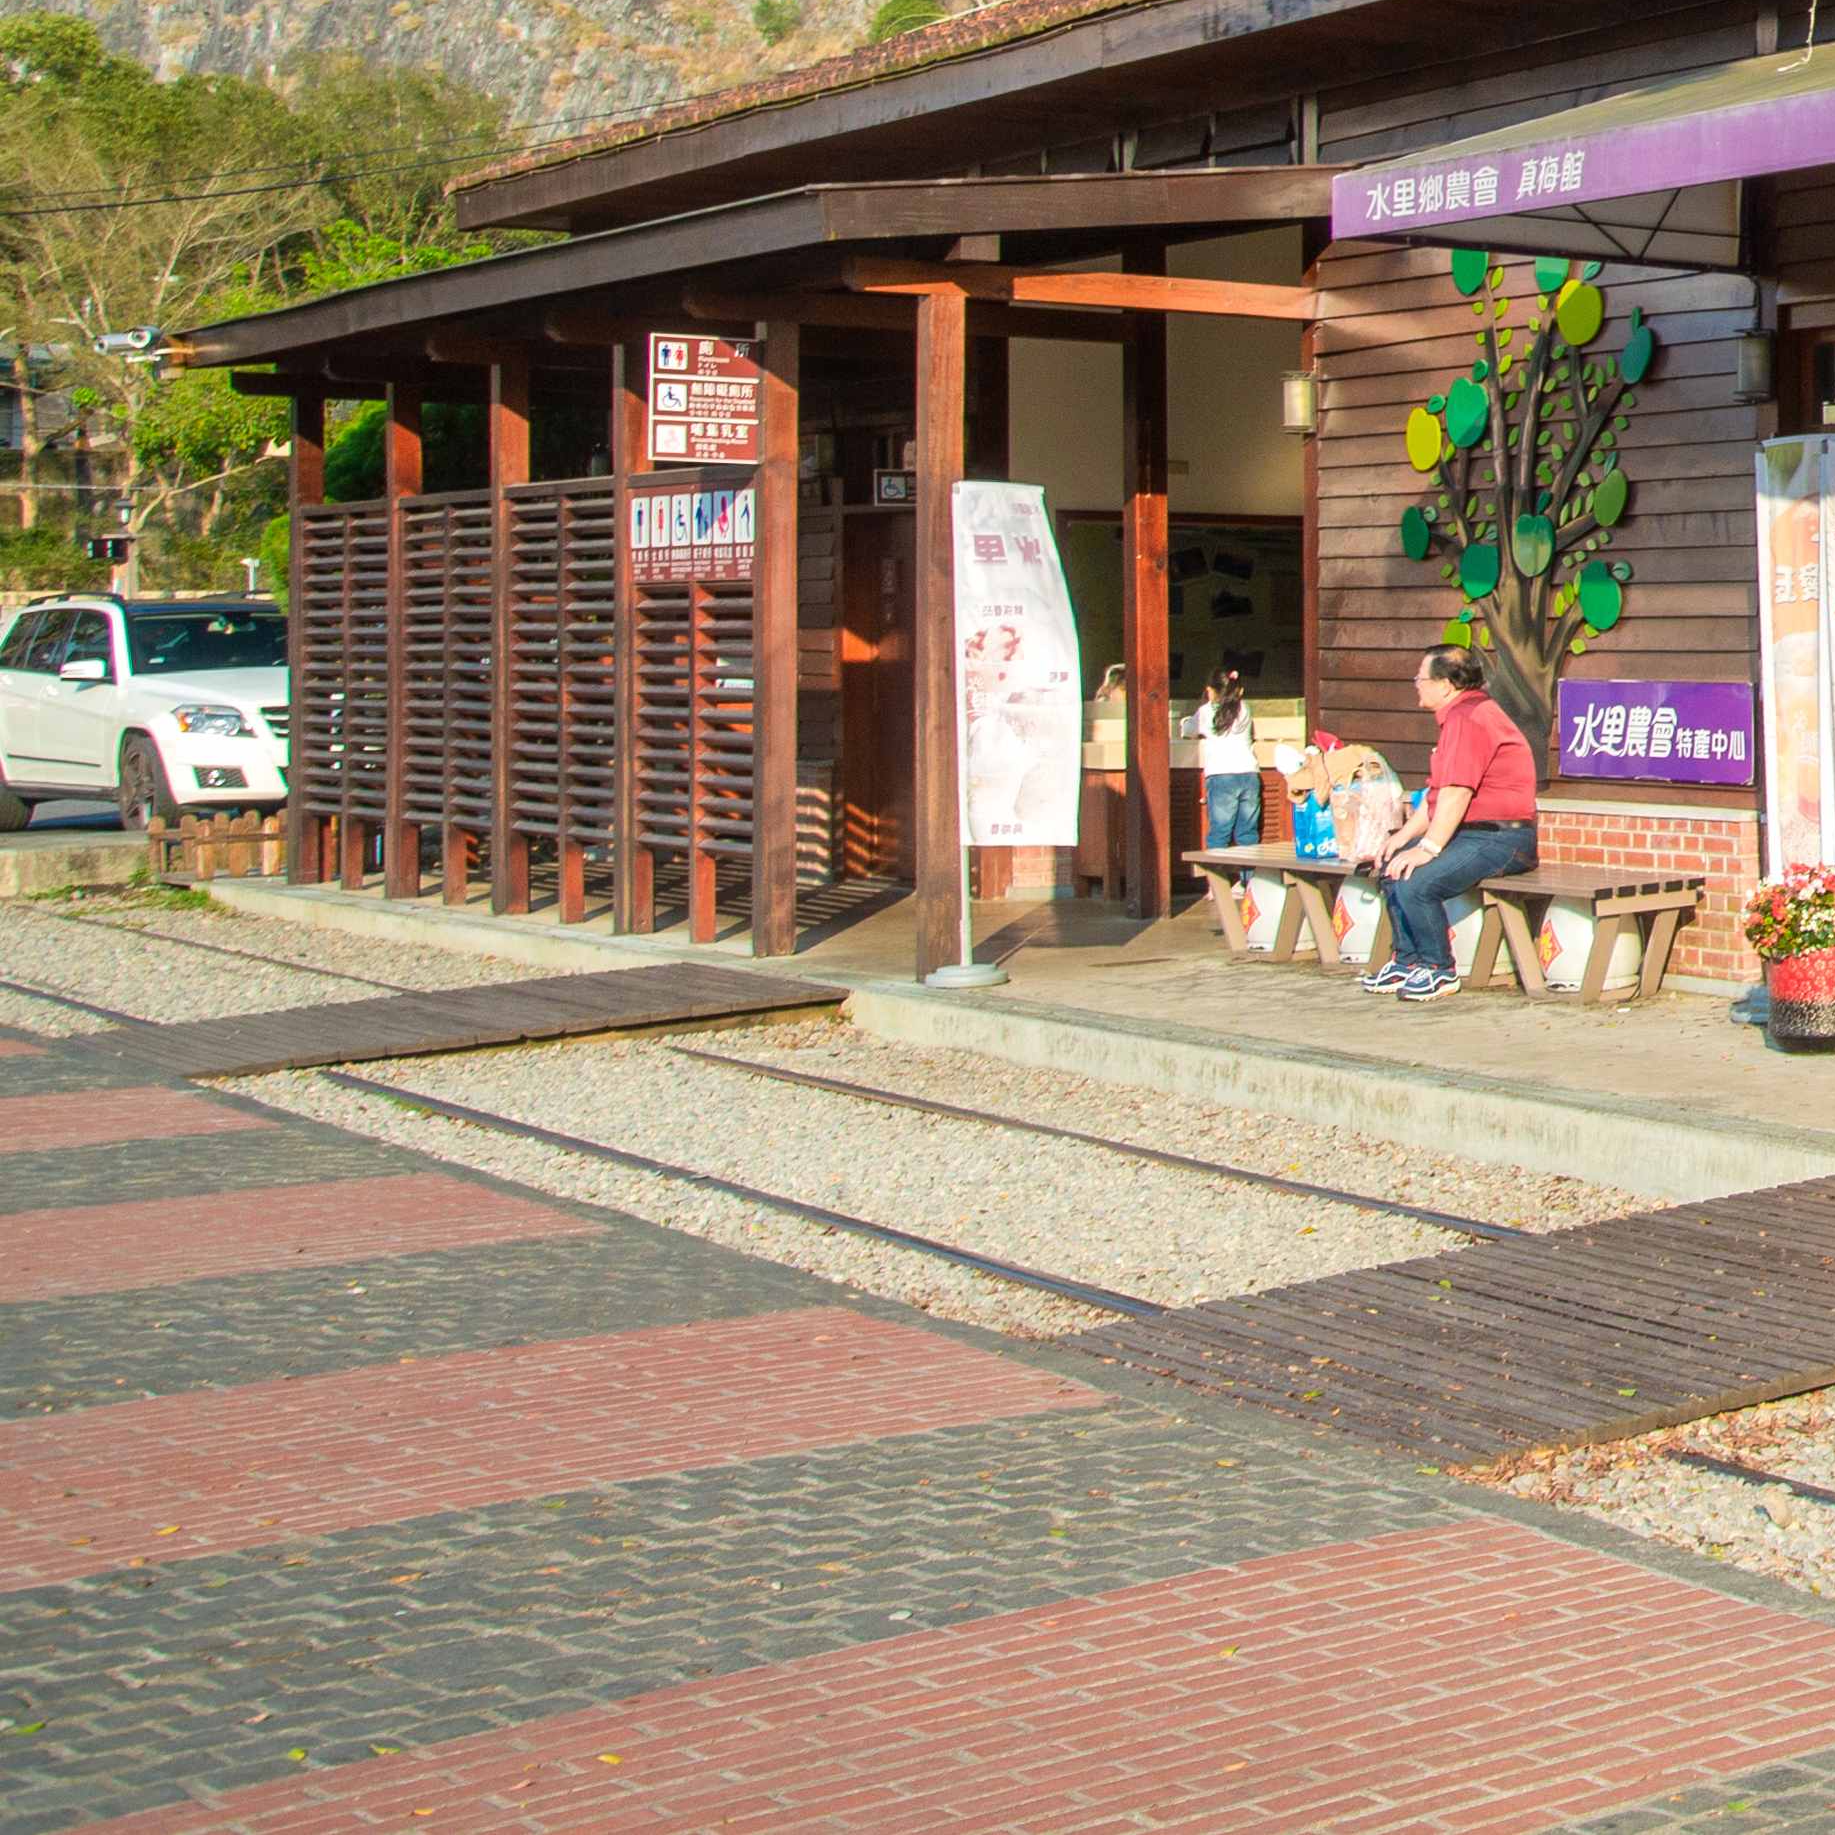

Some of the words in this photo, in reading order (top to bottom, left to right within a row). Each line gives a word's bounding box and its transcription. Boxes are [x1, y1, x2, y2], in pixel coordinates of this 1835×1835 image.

[1366, 166, 1499, 221] 水里鄉農會
[1515, 150, 1585, 201] 真梅館
[1567, 703, 1678, 758] 水里農會
[1676, 727, 1746, 761] 特產中心
